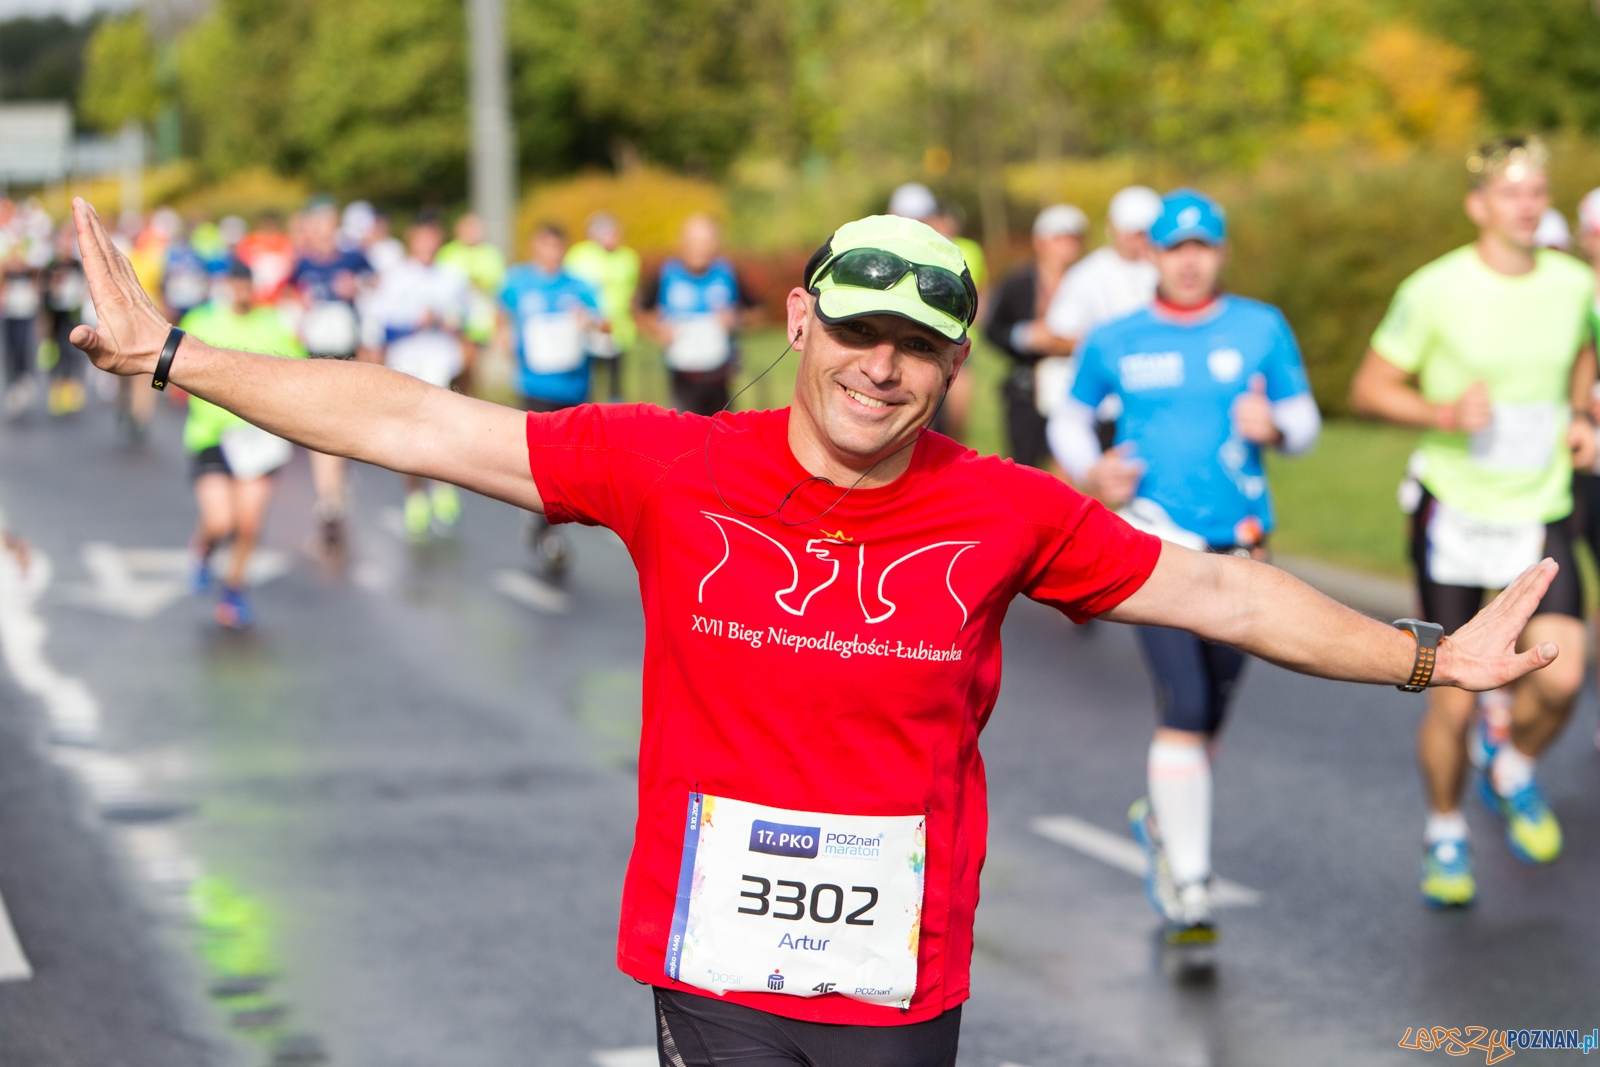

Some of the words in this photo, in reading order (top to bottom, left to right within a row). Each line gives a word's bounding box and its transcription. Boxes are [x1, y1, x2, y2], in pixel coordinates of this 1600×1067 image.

[691, 614, 723, 637] XVII
[728, 621, 764, 648] Bieg
[767, 626, 962, 662] Niepodległości-Łubianka
[757, 829, 777, 846] 17.
[779, 833, 814, 849] PKO
[824, 844, 879, 857] maraton
[737, 874, 879, 926] 3302
[778, 932, 830, 951] Artur
